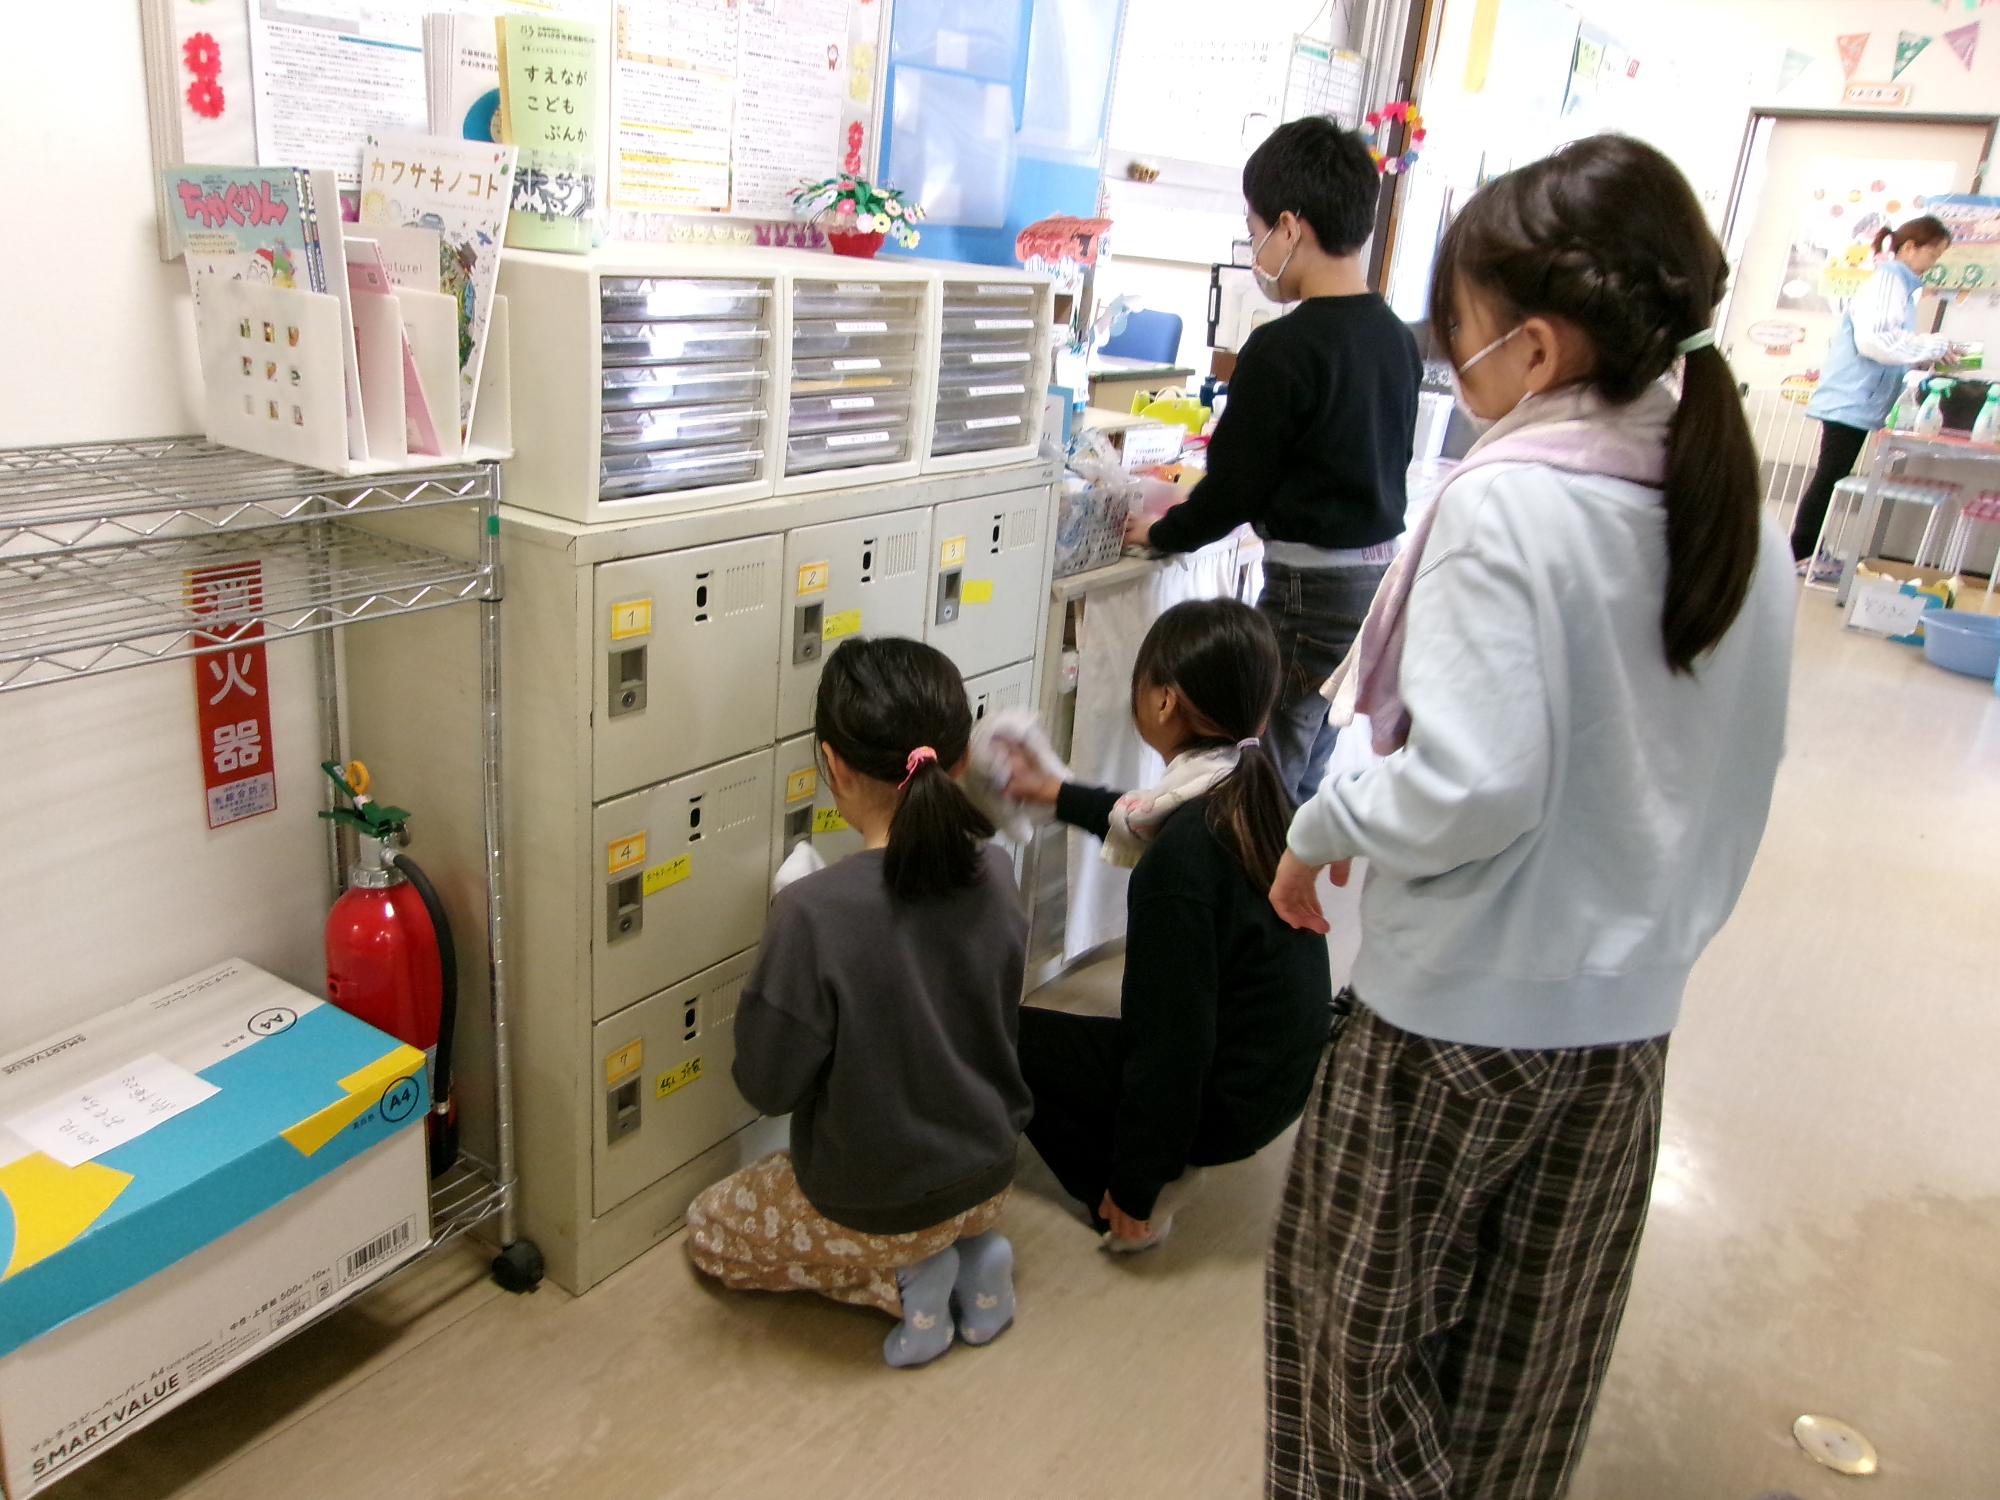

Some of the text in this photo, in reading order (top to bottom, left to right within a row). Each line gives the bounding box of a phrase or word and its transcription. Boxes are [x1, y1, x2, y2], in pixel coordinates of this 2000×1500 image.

[524, 64, 589, 87] すえなが
[528, 95, 575, 115] こども
[544, 124, 589, 144] ぶんか
[370, 157, 498, 200] カワサキノコト
[259, 1011, 285, 1031] A4
[388, 1087, 412, 1112] A4
[31, 1371, 181, 1478] SMARTVALUE
